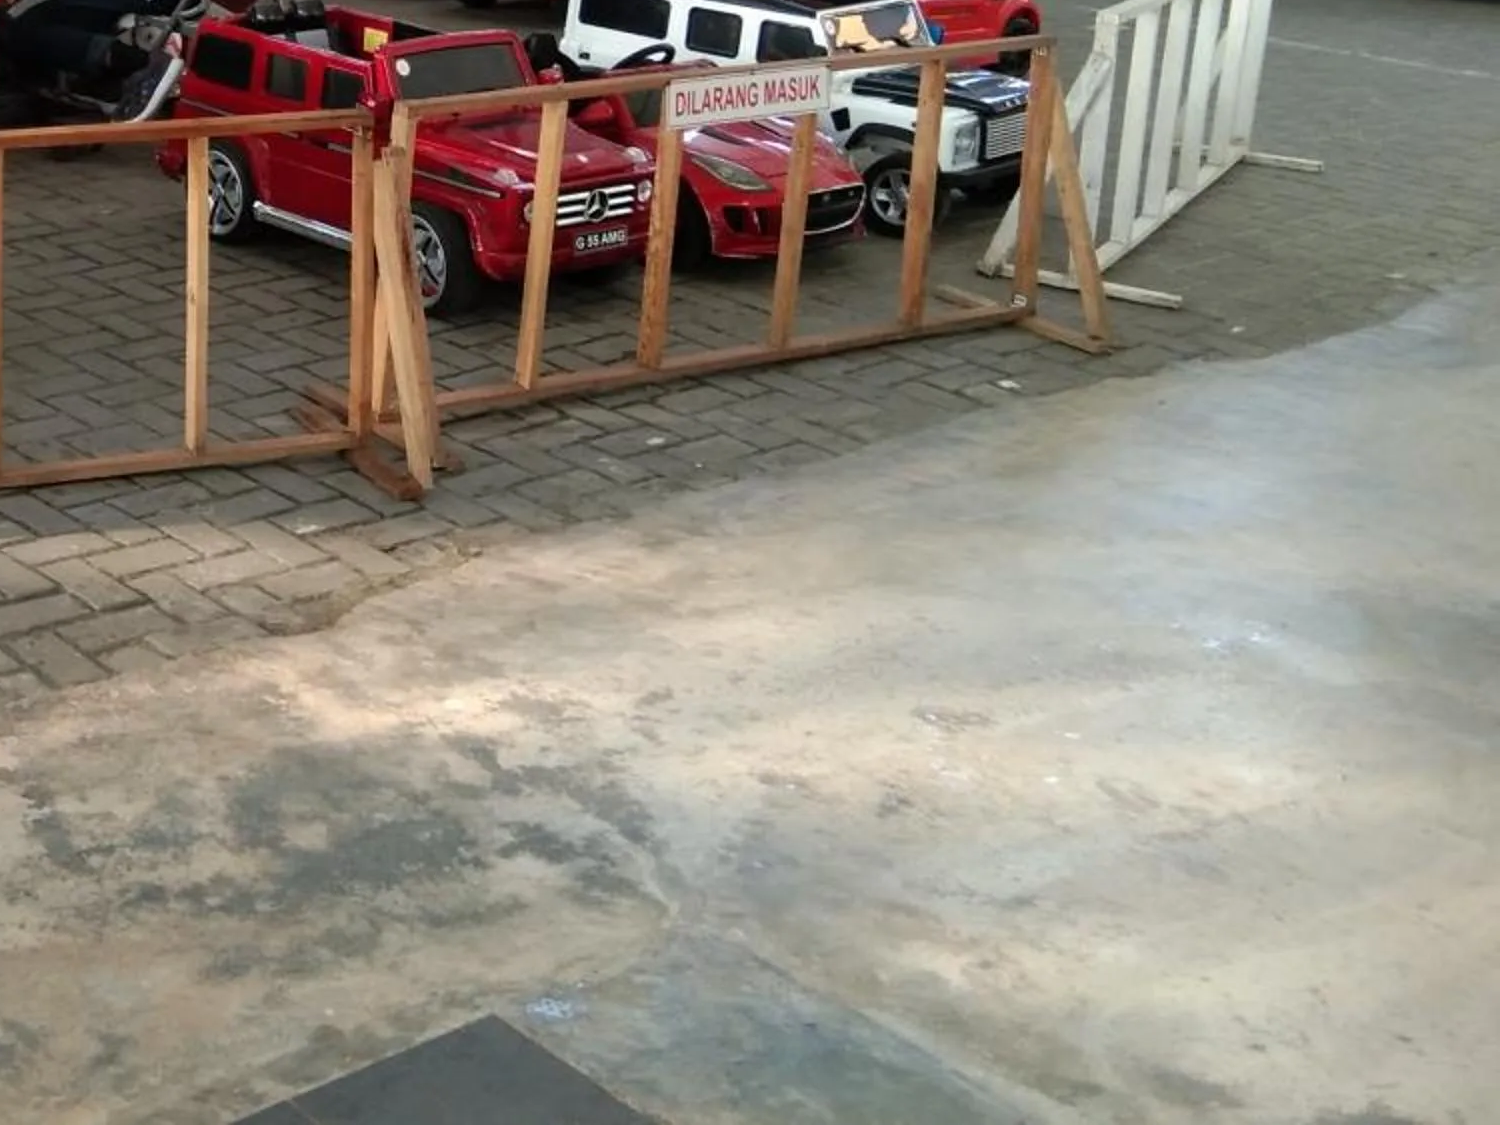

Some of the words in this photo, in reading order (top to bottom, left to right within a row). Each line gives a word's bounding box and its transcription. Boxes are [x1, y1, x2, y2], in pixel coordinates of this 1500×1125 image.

[675, 81, 759, 117] DILARANG
[763, 75, 821, 106] MASUK
[575, 236, 585, 250] G
[601, 230, 625, 244] AMG
